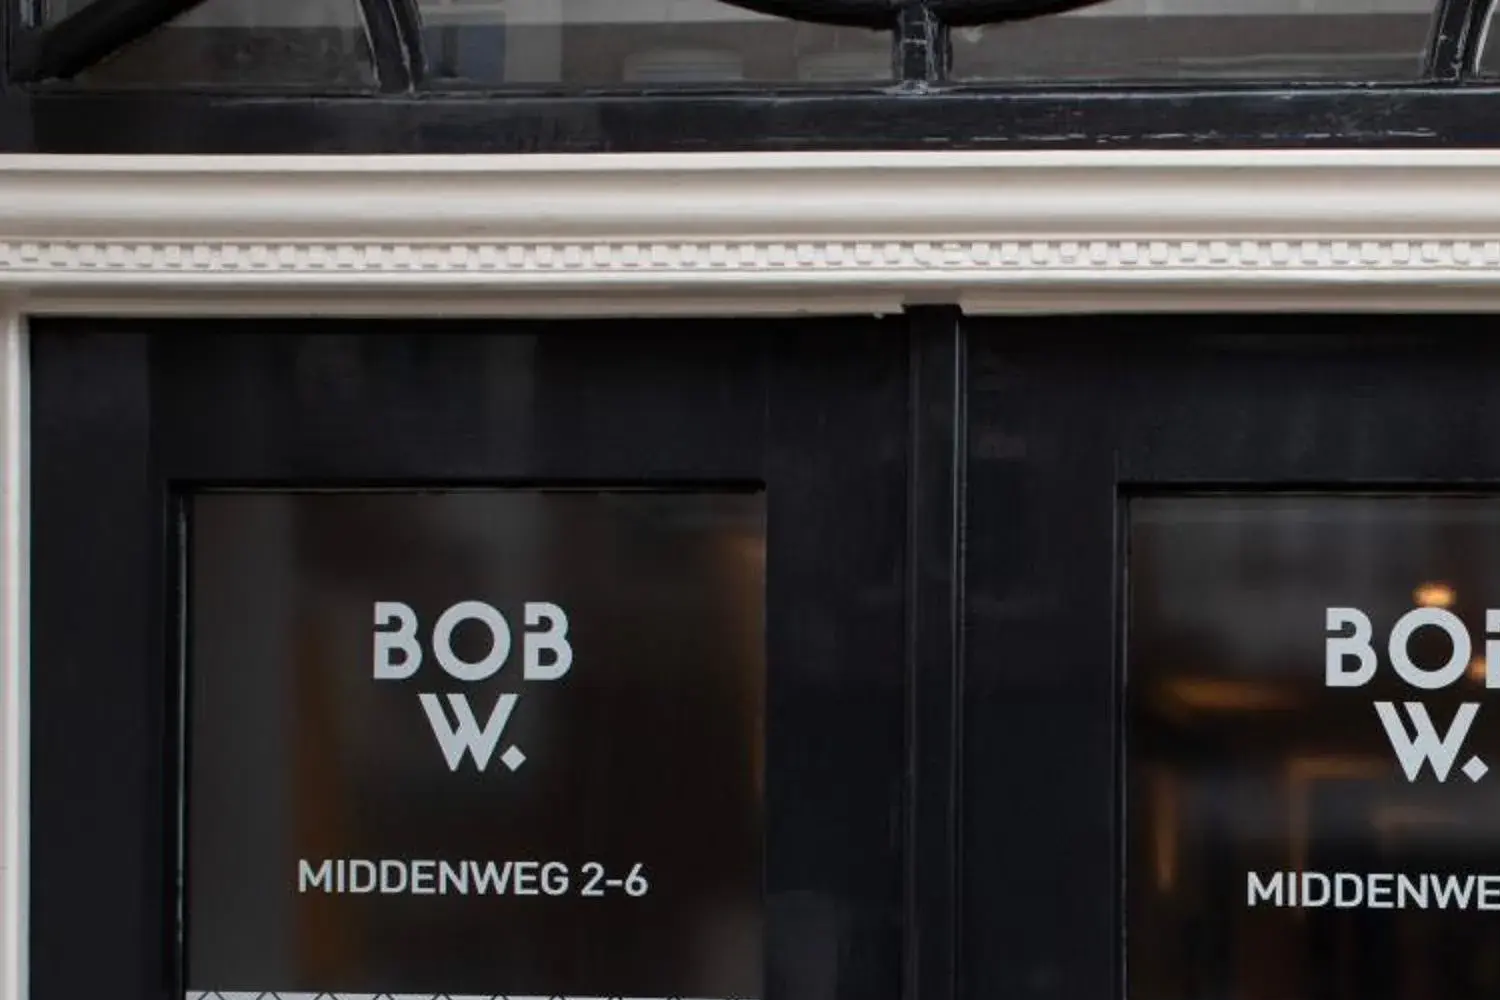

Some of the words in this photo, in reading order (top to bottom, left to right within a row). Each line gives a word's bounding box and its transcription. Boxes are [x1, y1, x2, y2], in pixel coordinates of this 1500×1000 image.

[373, 600, 573, 681] BOB
[418, 693, 526, 771] W.
[1373, 701, 1489, 783] W.
[299, 859, 569, 895] MIDDENWEG
[581, 862, 648, 897] 2-6
